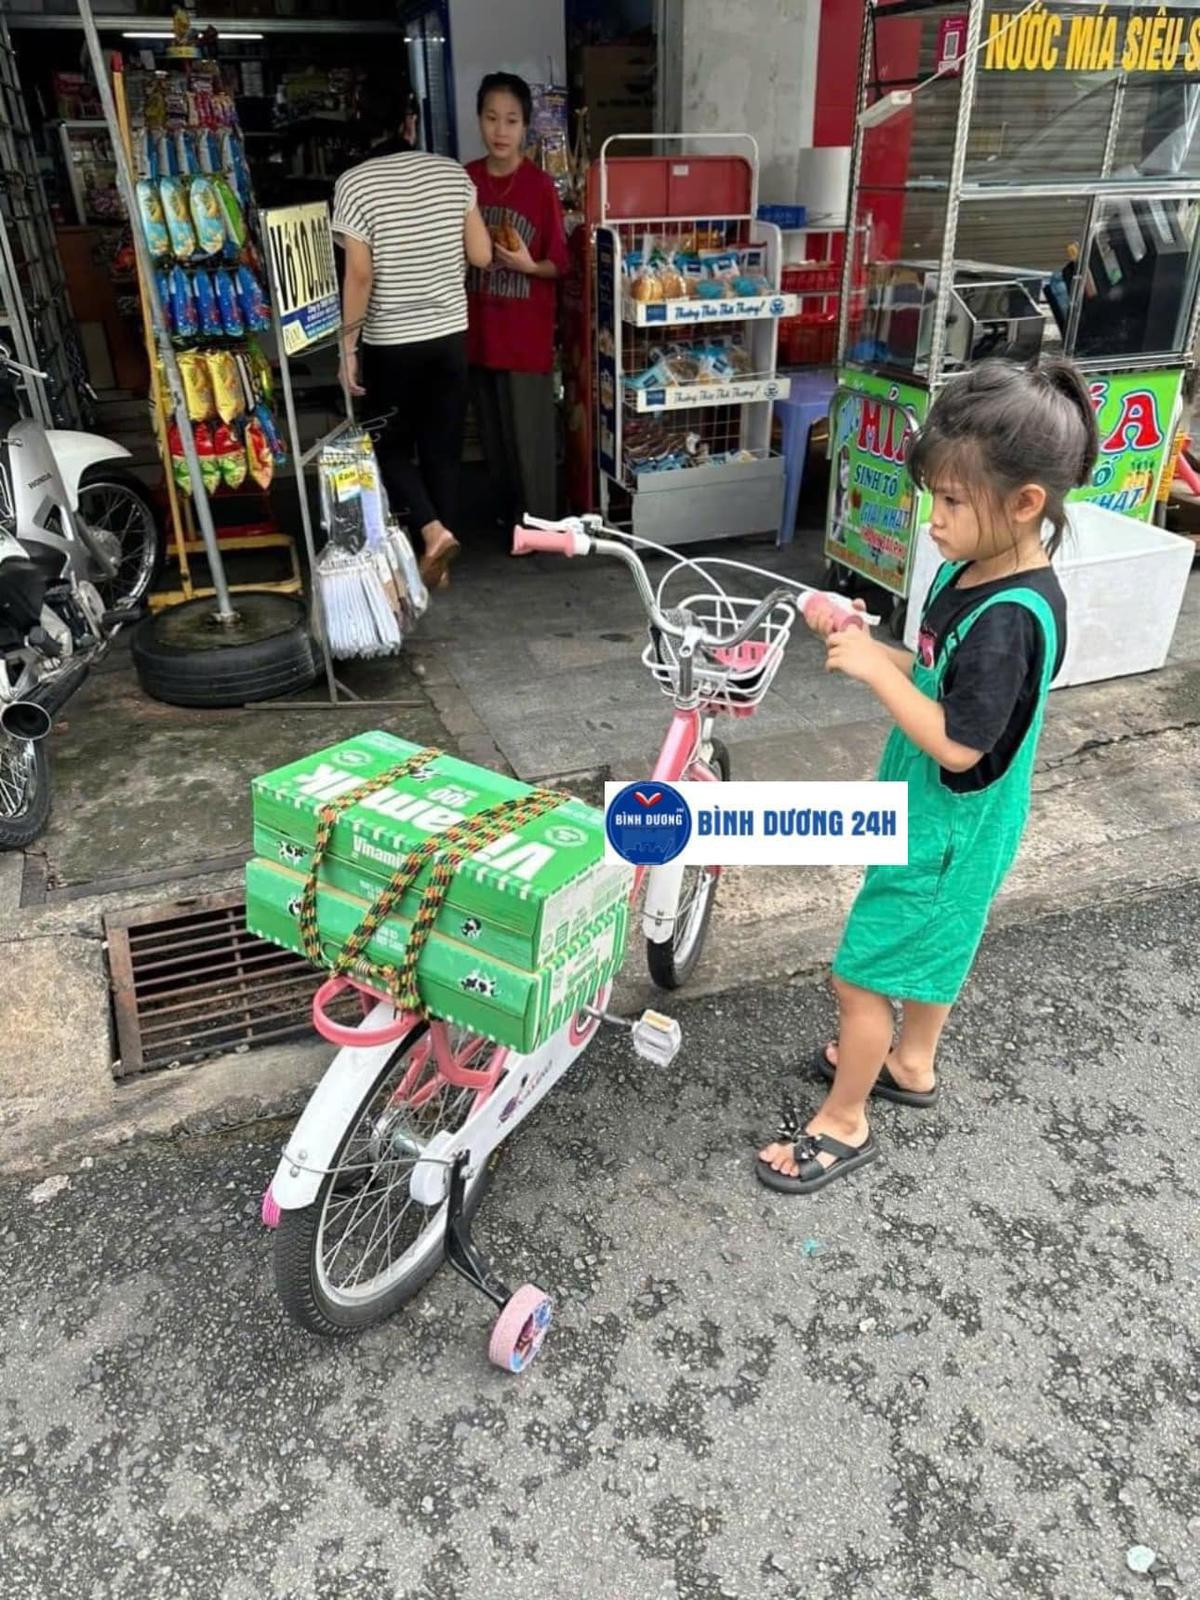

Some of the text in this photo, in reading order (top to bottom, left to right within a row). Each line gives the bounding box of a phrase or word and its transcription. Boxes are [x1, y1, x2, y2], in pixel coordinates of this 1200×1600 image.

[985, 3, 1062, 70] NƯỚC
[1065, 3, 1118, 70] MÍA
[1121, 6, 1183, 71] SIÊU
[854, 463, 881, 490] SINH
[292, 763, 556, 882] Viamlk
